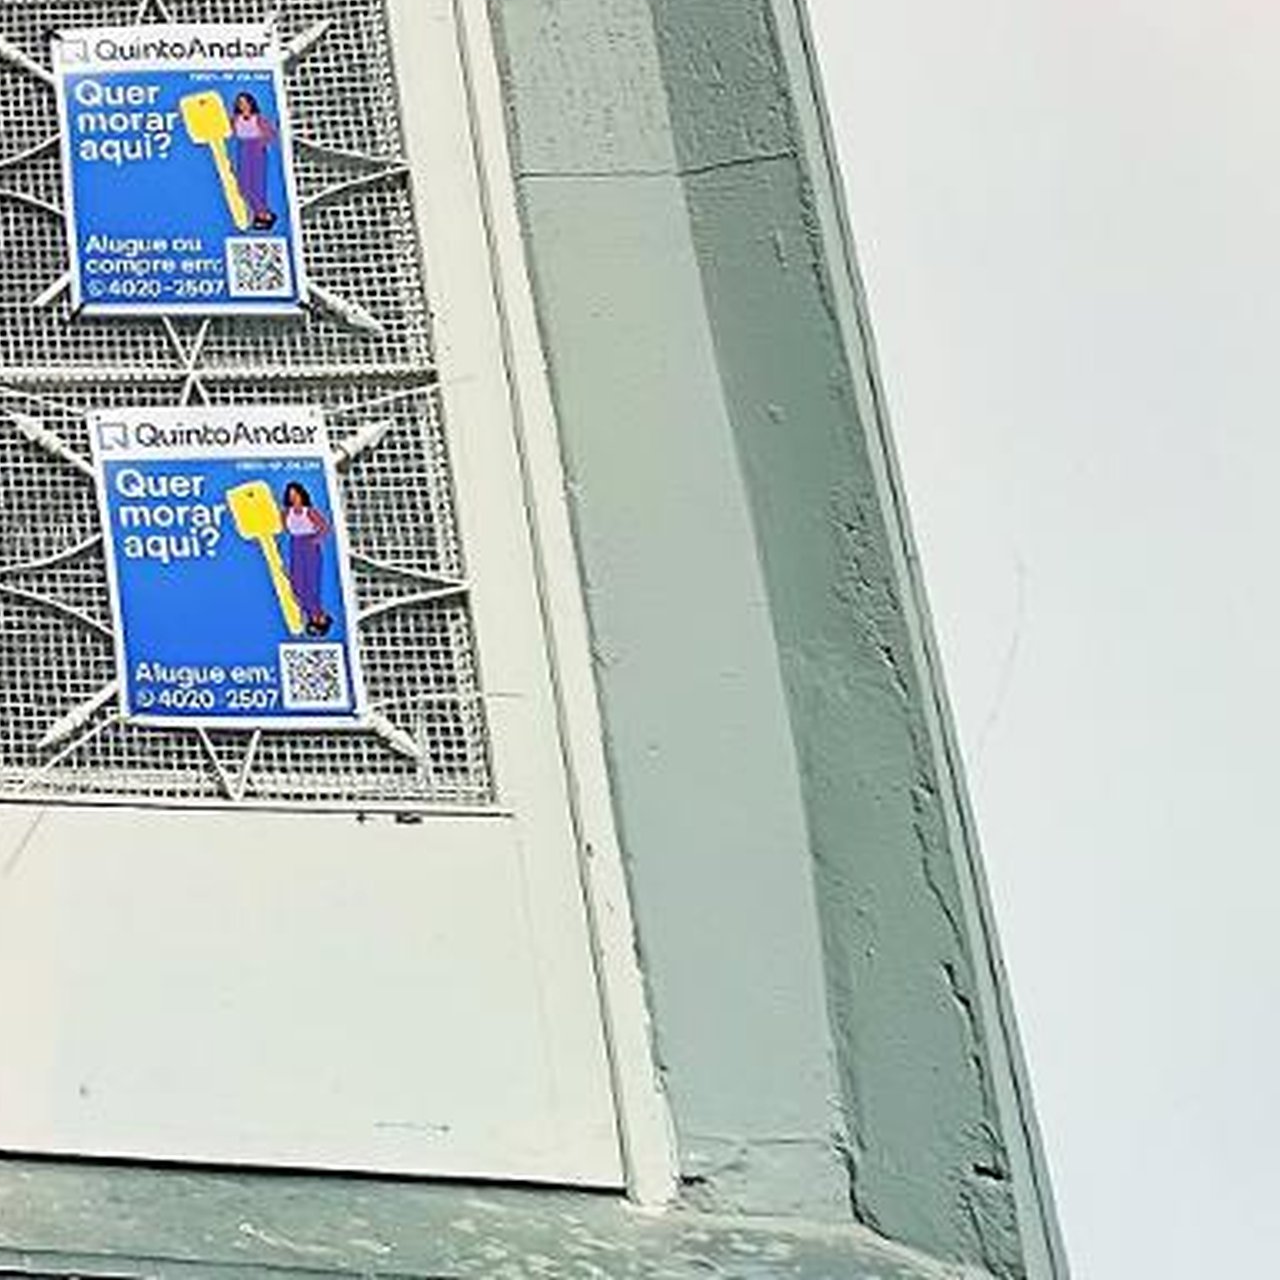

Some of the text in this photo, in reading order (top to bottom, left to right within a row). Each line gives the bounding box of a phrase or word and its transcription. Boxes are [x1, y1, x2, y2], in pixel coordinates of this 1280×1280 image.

[95, 37, 270, 62] QuintoAndar
[75, 79, 160, 107] Quer
[78, 112, 179, 133] morar
[80, 134, 172, 167] aqui?
[85, 235, 203, 257] Alugue ou
[85, 258, 176, 275] compre
[136, 422, 318, 448] QuintoAndar
[116, 468, 205, 498] Quer
[120, 503, 225, 527] morar
[125, 527, 220, 564] aqui?
[136, 662, 278, 688] Alugue em:
